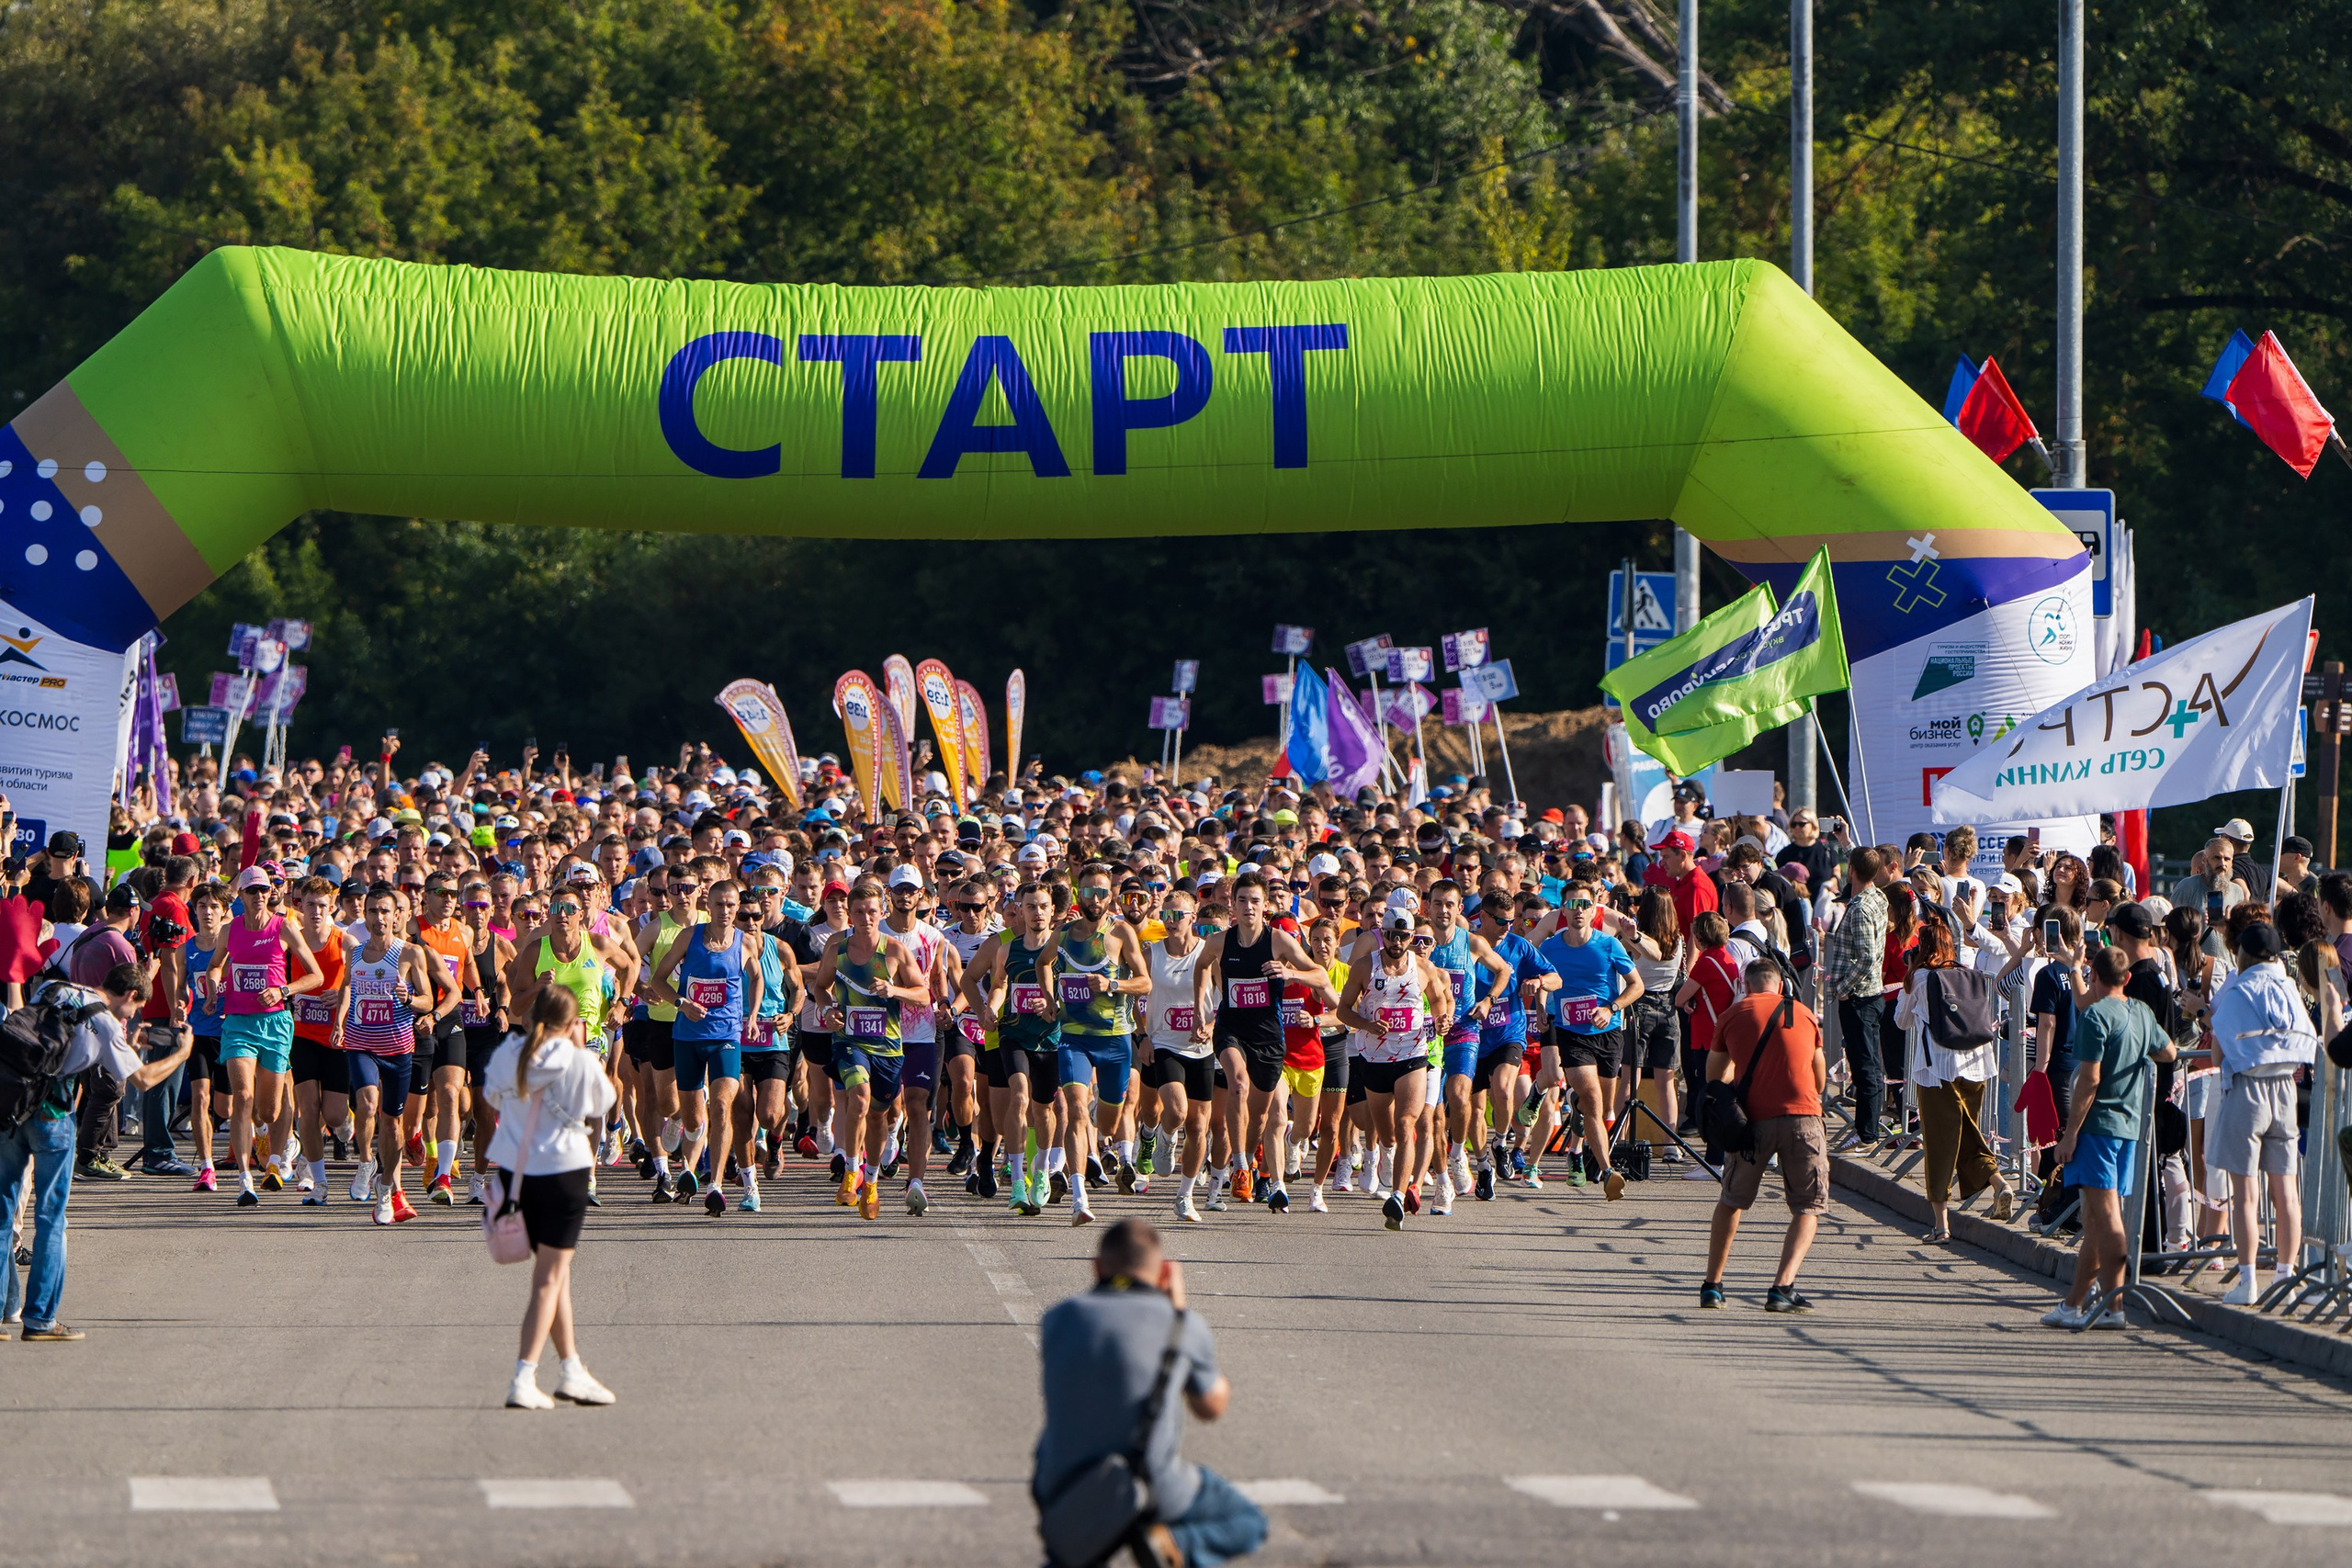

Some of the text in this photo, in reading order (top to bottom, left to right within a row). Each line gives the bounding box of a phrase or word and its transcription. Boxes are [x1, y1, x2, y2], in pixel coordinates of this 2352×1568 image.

[659, 323, 1349, 479] СТАРТ
[0, 673, 67, 688] мастер PRO
[1930, 716, 1961, 729] мой
[1909, 727, 1962, 740] бизнес
[35, 768, 74, 781] туризма
[6, 779, 48, 792] области
[243, 978, 266, 990] 2589
[355, 980, 393, 996] RUSSIA
[697, 992, 723, 1004] 4296
[1068, 987, 1091, 999] 5210
[1242, 991, 1266, 1005] 1818
[305, 1009, 329, 1021] 3093
[366, 1009, 390, 1021] 4714
[1487, 1012, 1507, 1025] 824
[860, 1021, 883, 1033] 1341
